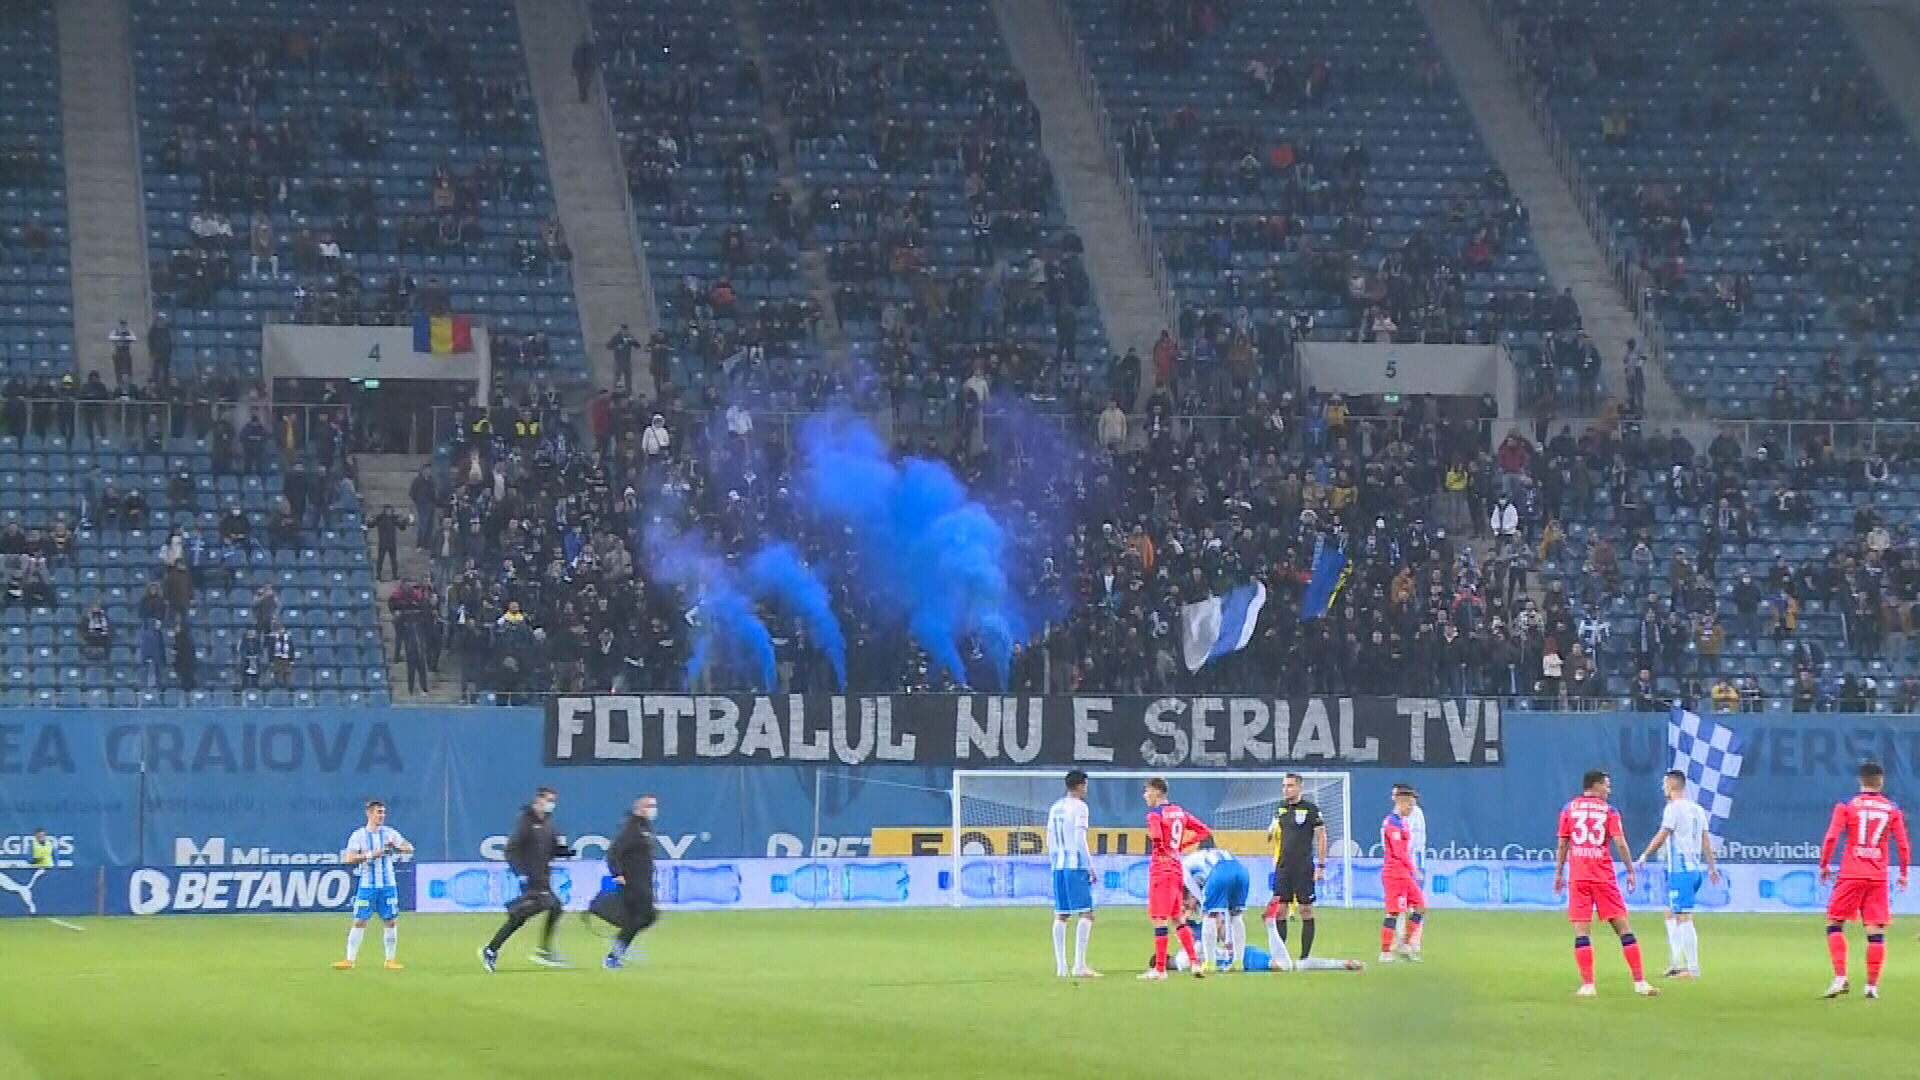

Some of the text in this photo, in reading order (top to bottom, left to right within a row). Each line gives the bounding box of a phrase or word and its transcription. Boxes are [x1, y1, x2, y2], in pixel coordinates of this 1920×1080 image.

[367, 343, 381, 362] 4
[1385, 360, 1397, 378] 5
[105, 722, 404, 774] CRAIOVA
[556, 694, 1500, 767] FOTBALUL NU E SERIAL TV!
[1170, 819, 1183, 849] 9
[1571, 811, 1608, 846] 33
[1857, 811, 1890, 846] 17
[173, 868, 350, 910] BETANO
